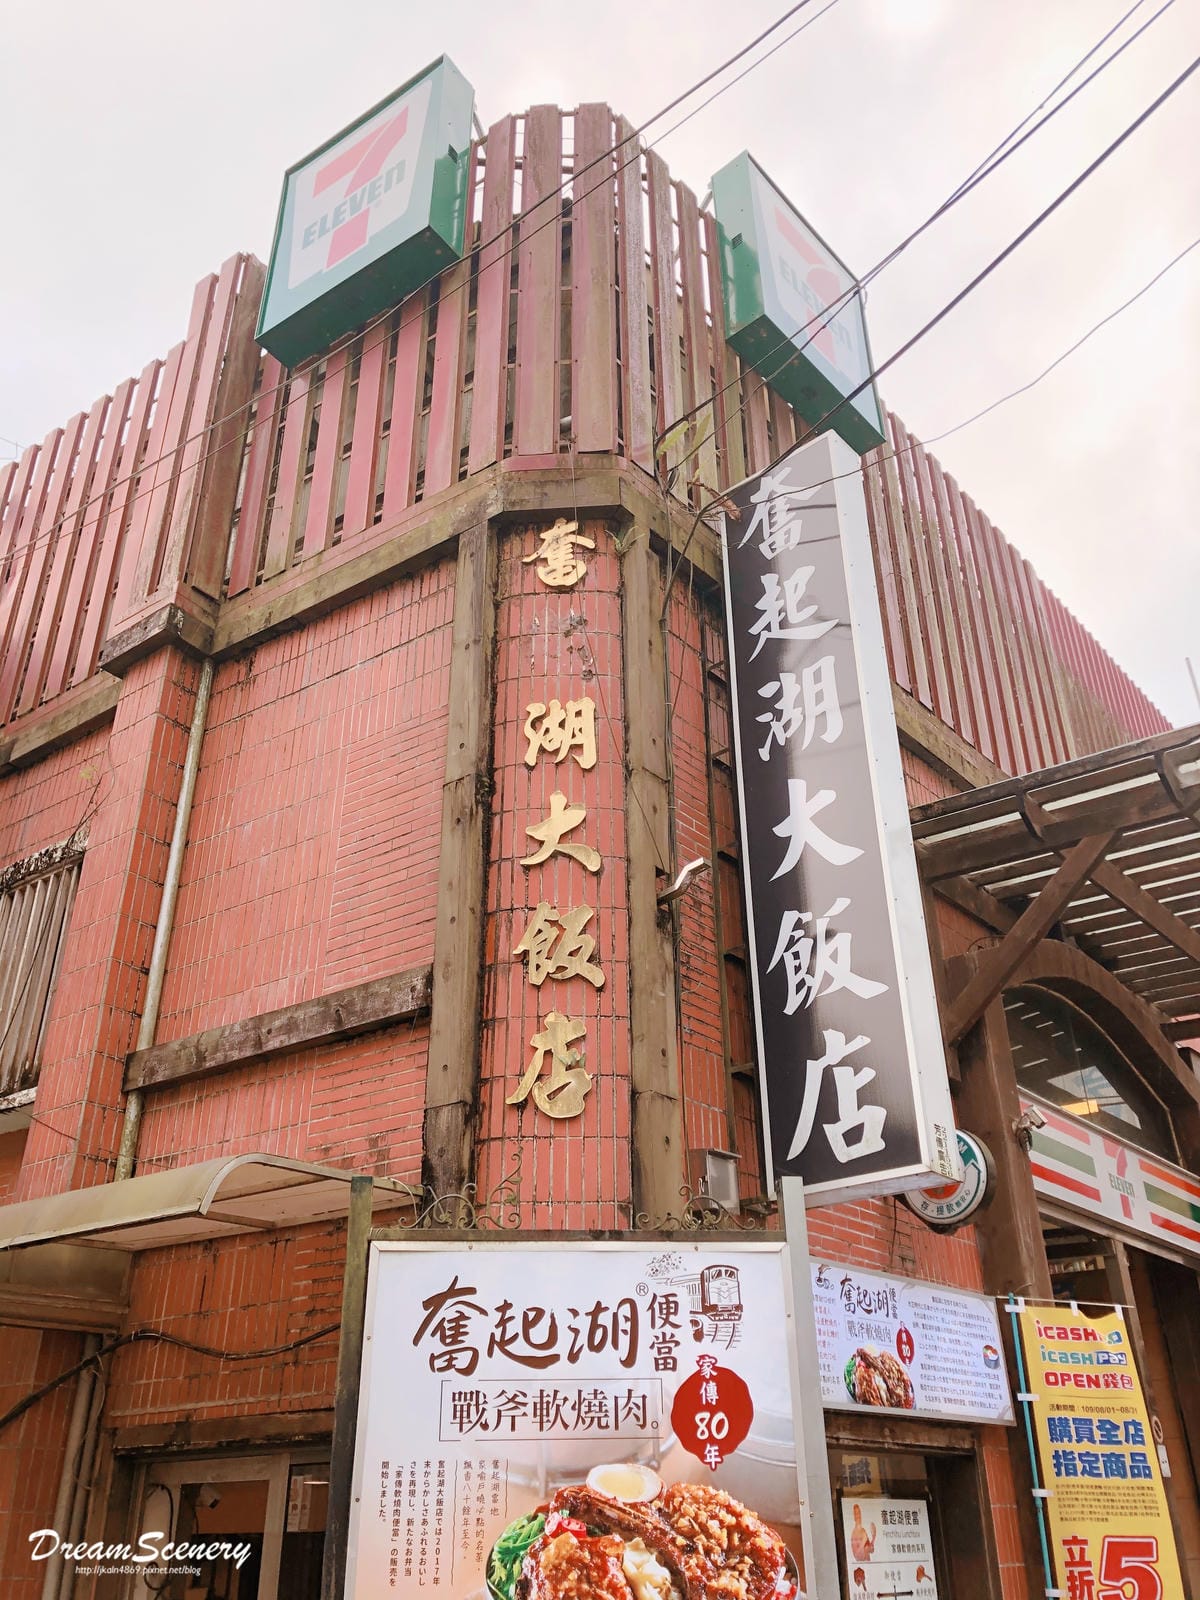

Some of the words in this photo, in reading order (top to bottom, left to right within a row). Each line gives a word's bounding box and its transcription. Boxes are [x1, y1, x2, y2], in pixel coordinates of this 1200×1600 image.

[312, 105, 408, 269] 7
[737, 467, 889, 1163] 奮起湖大飯店
[1103, 1138, 1134, 1220] 7
[412, 1275, 639, 1376] 奮起湖
[646, 1292, 682, 1372] 便當
[840, 1274, 889, 1318] 奮起湖
[1047, 1417, 1146, 1446] 購買全店
[1052, 1450, 1153, 1480] 指定商品
